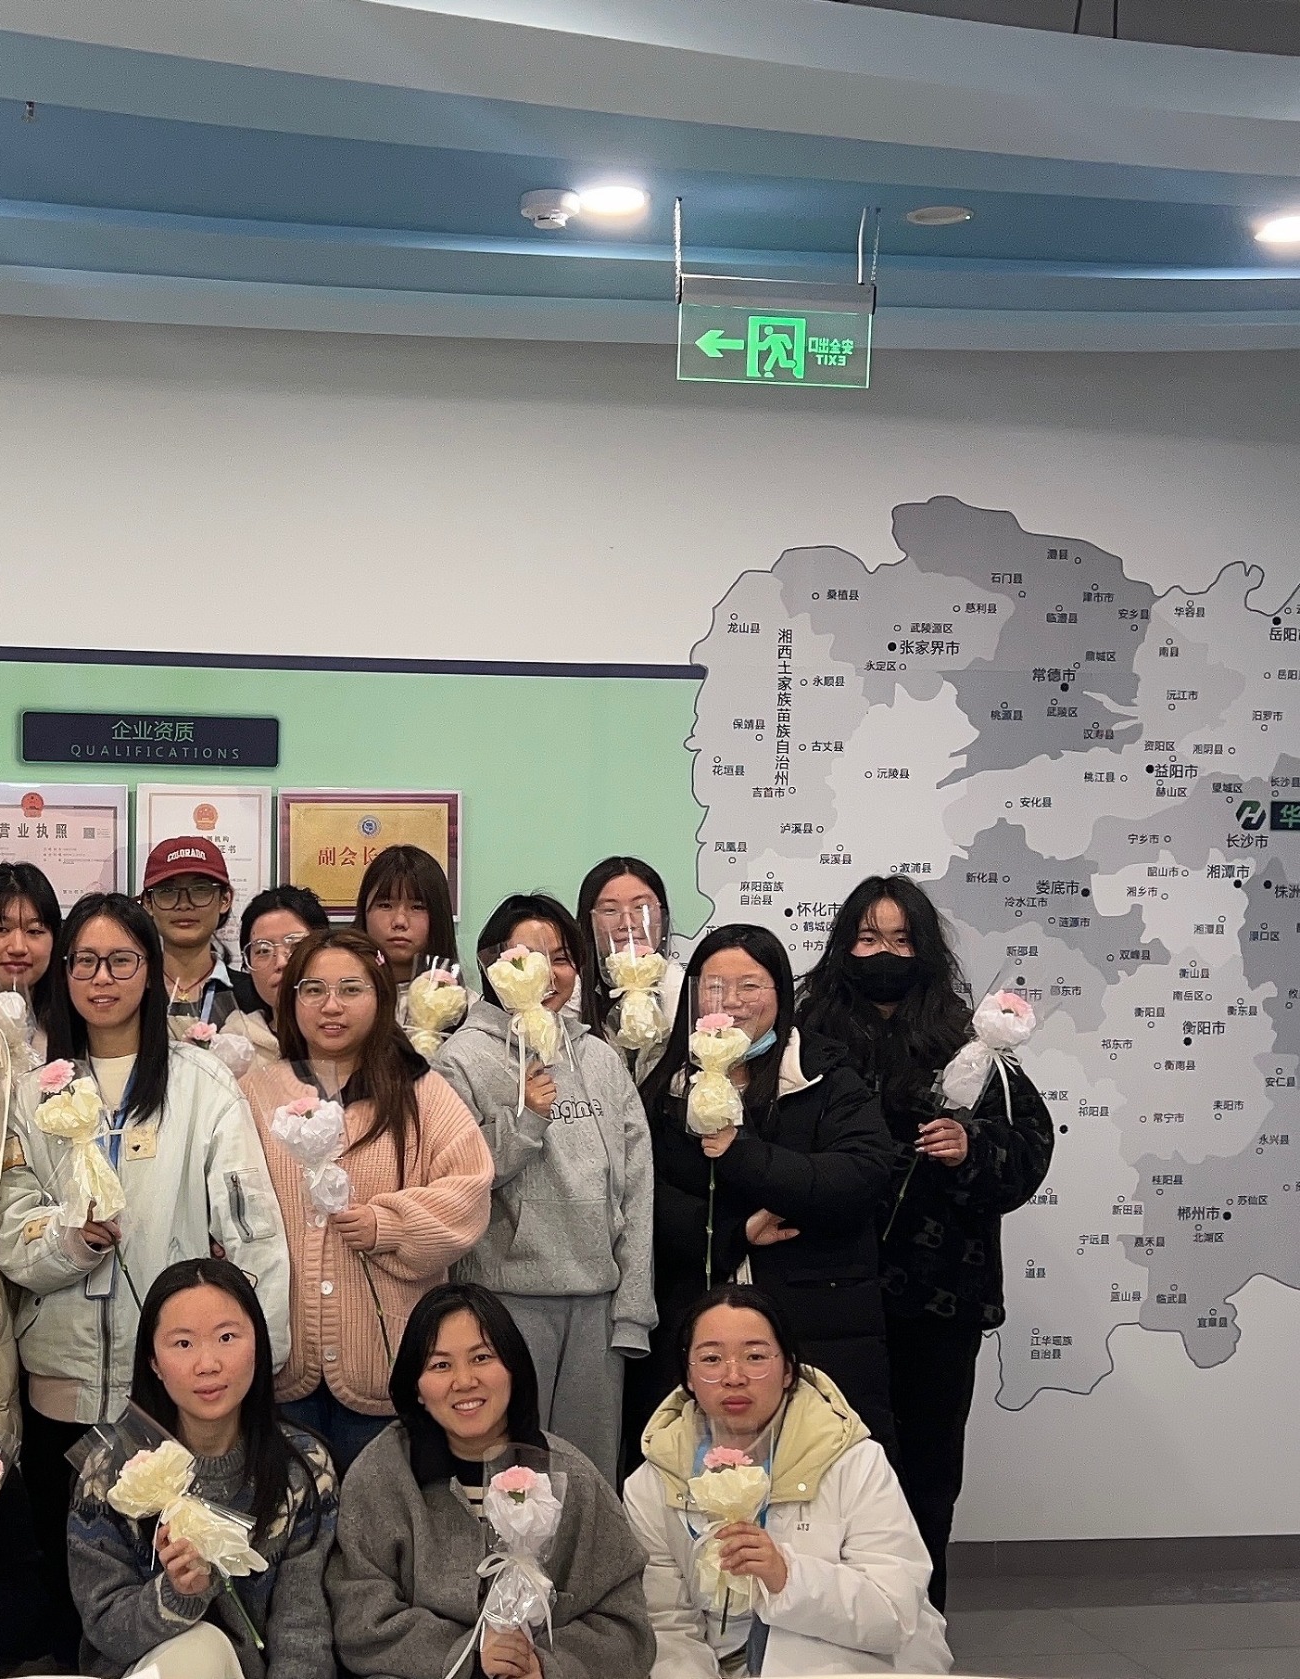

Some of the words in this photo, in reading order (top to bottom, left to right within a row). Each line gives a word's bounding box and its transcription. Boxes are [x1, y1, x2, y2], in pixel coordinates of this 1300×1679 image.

[991, 573, 1022, 584] 石门县
[827, 589, 859, 600] 桑植县
[1083, 592, 1115, 602] 津市市
[965, 603, 997, 614] 慈利县
[1174, 607, 1204, 617] 华容县
[1046, 613, 1077, 623] 临澧县
[1118, 609, 1149, 619] 安乡县
[728, 623, 760, 633] 龙山县
[911, 623, 953, 633] 武陵源区
[1269, 627, 1300, 641] 岳阳
[900, 640, 960, 655] 张家界市
[1159, 647, 1178, 657] 南县
[1085, 651, 1116, 661] 鼎城区
[864, 661, 896, 671] 永定区
[1033, 667, 1077, 682] 常德市
[1278, 670, 1300, 680] 岳阳
[813, 676, 845, 686] 永顺县
[1167, 690, 1198, 700] 沅江市
[775, 629, 792, 785] 湘西土家族苗族自治州
[1047, 707, 1078, 717] 武陵区
[991, 710, 1023, 720] 桃源县
[733, 719, 765, 729] 保靖县
[111, 718, 194, 742] 企业资质
[1084, 728, 1114, 739] 汉寿县
[812, 741, 843, 752] 古丈县
[1144, 741, 1175, 751] 资阳区
[70, 743, 241, 760] QUALIFICATIONS
[712, 765, 745, 775] 花垣县
[877, 768, 909, 779] 沅陵县
[1155, 764, 1198, 778] 益阳市
[1084, 772, 1115, 782] 桃江县
[752, 787, 785, 797] 吉首市
[1156, 787, 1187, 797] 赫山区
[1212, 783, 1243, 793] 望城区
[1020, 797, 1052, 807] 安化县
[780, 823, 813, 834] 泸溪县
[1128, 834, 1159, 844] 宁乡市
[1226, 834, 1268, 848] 长沙市
[715, 842, 747, 852] 凤凰县
[167, 847, 207, 862] COLORADO
[318, 846, 378, 866] 副会长
[820, 854, 851, 864] 辰溪县
[1148, 867, 1179, 877] 韶山市
[1207, 865, 1251, 879] 湘潭市
[966, 872, 998, 883] 新化县
[740, 881, 783, 892] 麻阳苗族
[1036, 880, 1079, 895] 娄底市
[1127, 887, 1158, 897] 湘乡市
[741, 895, 773, 905] 自治县
[1005, 897, 1048, 907] 冷水江市
[796, 903, 840, 917] 怀化市
[1059, 917, 1090, 927] 涟源市
[1194, 924, 1224, 934] 湘潭县
[802, 940, 827, 950] 中方
[1007, 946, 1038, 956] 新邵县
[1119, 950, 1150, 960] 双峰县
[1179, 969, 1209, 978] 衡山县
[1173, 991, 1203, 1001] 南岳区
[1135, 1007, 1165, 1017] 衡阳县
[1227, 1006, 1257, 1016] 衡东县
[1183, 1021, 1225, 1035] 衡阳市
[1165, 1060, 1195, 1070] 衡南县
[1265, 1077, 1295, 1087] 安仁县
[1078, 1107, 1109, 1116] 祁阳县
[1154, 1113, 1184, 1123] 常宁市
[1259, 1134, 1289, 1145] 永兴县
[1152, 1175, 1183, 1185] 桂阳县
[1112, 1205, 1143, 1215] 新田县
[1178, 1206, 1220, 1220] 郴州市
[1079, 1235, 1109, 1244] 宁远县
[1193, 1233, 1224, 1242] 北湖区
[1026, 1268, 1045, 1278] 道县
[1156, 1294, 1186, 1304] 临武县
[1030, 1336, 1072, 1346] 江华瑶族
[1031, 1349, 1061, 1359] 自治县
